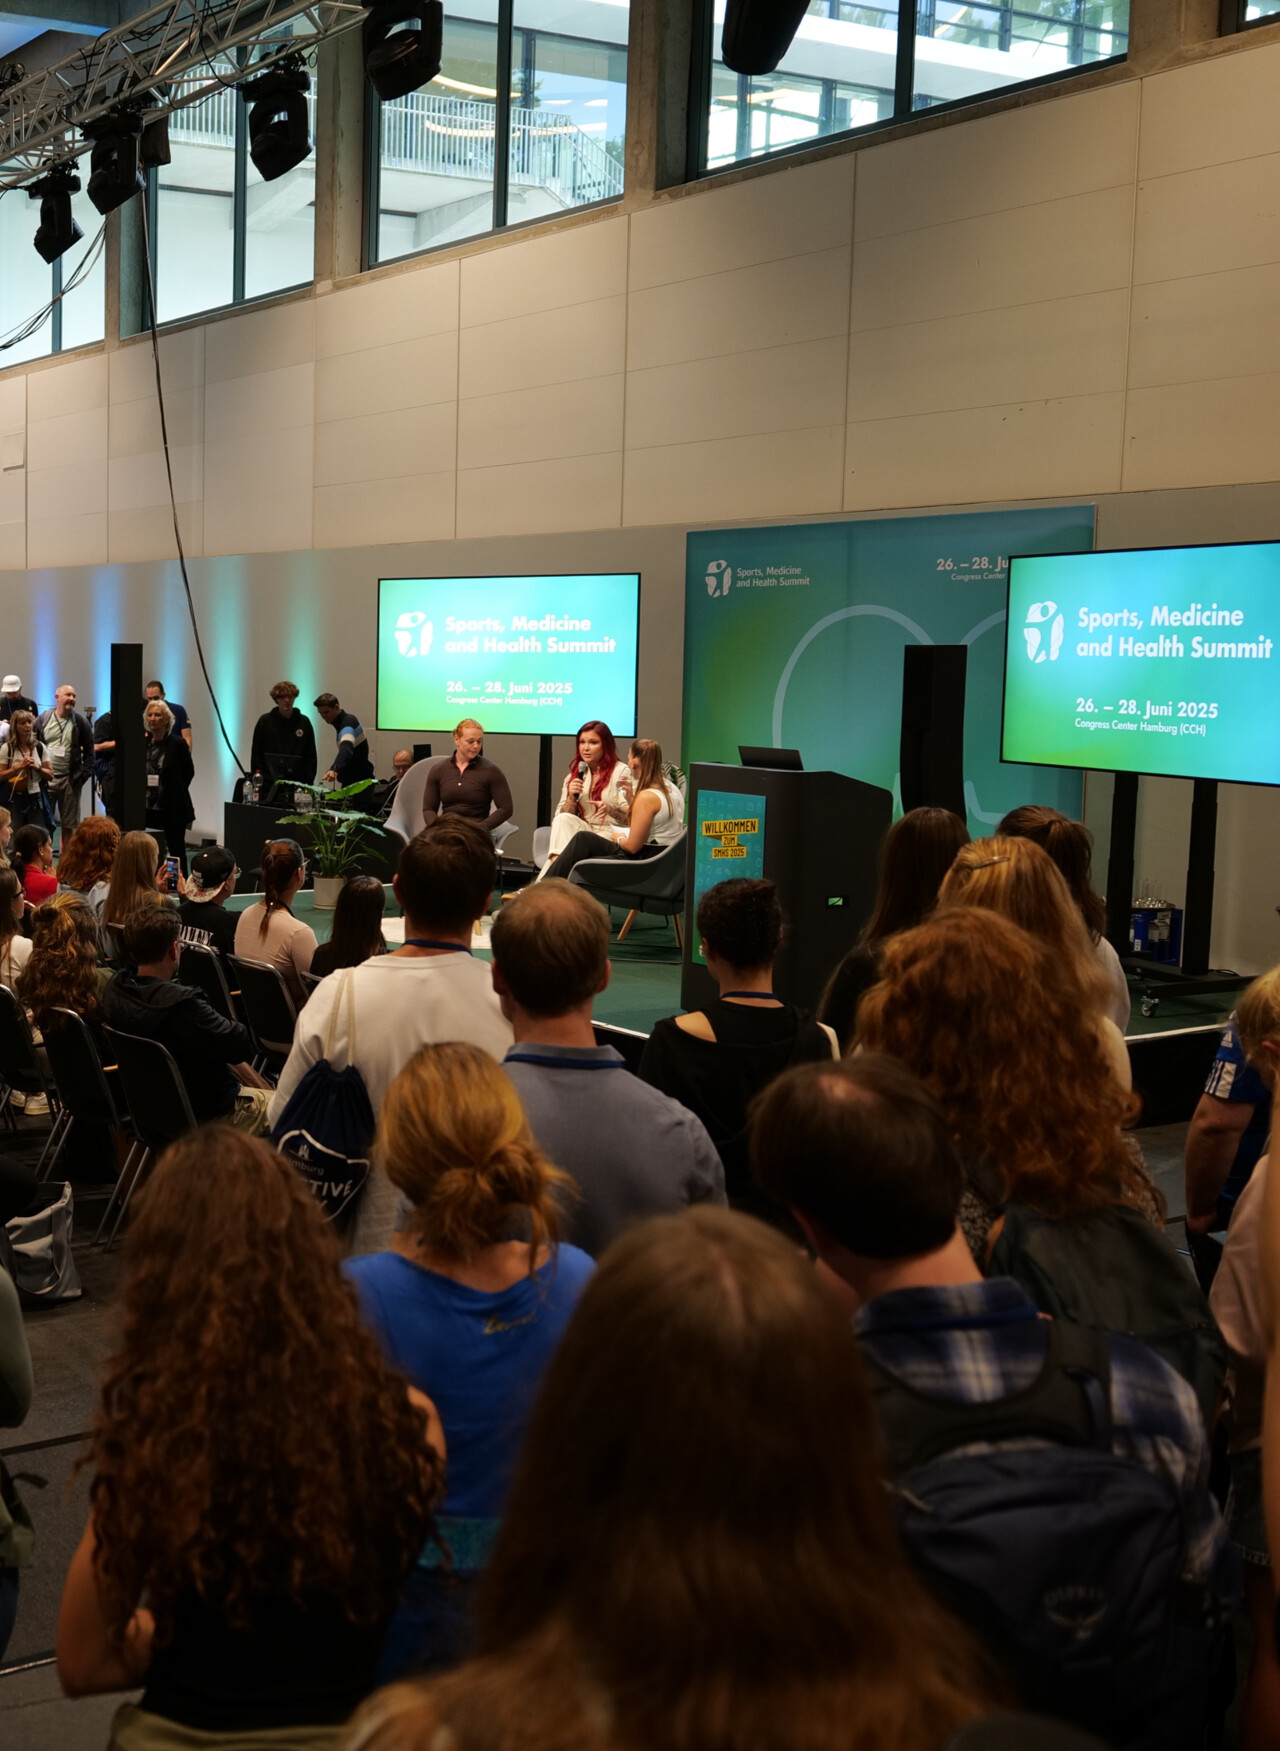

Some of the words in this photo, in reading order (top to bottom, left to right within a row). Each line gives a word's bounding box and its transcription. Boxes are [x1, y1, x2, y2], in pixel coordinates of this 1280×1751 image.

[936, 558, 958, 571] 26.
[971, 556, 993, 569] 28.
[994, 555, 1009, 571] Ju
[736, 567, 764, 579] Sports,
[766, 565, 802, 576] Medicine
[951, 573, 982, 582] Congress
[983, 572, 1007, 580] Center
[736, 578, 751, 587] and
[752, 577, 778, 587] Health
[779, 576, 810, 586] Summit
[444, 615, 506, 636] Sports,
[510, 613, 592, 632] Medicine
[1077, 606, 1144, 633] Sports,
[1149, 602, 1244, 627] Medicine
[444, 636, 479, 653] and
[483, 636, 542, 653] Health
[546, 636, 617, 653] Summit
[1076, 634, 1113, 657] and
[1118, 634, 1185, 657] Health
[1190, 634, 1273, 659] Summit
[446, 680, 468, 693] 26.
[484, 681, 506, 694] 28.
[507, 681, 533, 697] Juni
[535, 682, 573, 695] 2025
[445, 696, 478, 705] Congress
[480, 696, 503, 704] Center
[505, 697, 538, 707] Hamburg
[539, 697, 563, 707] (CCH)
[1076, 697, 1099, 713] 26.
[1118, 699, 1142, 715] 28.
[1142, 700, 1173, 719] Juni
[1177, 701, 1219, 719] 2025
[1075, 718, 1110, 731] Congress
[1111, 720, 1138, 731] Center
[1140, 721, 1177, 736] Hamburg
[1179, 722, 1206, 737] (CCH)
[704, 820, 757, 834] WILLKOMMEN
[723, 836, 736, 846] ZUM
[730, 848, 745, 857] 2025
[290, 1160, 325, 1176] mburg
[300, 1178, 353, 1198] TIVE
